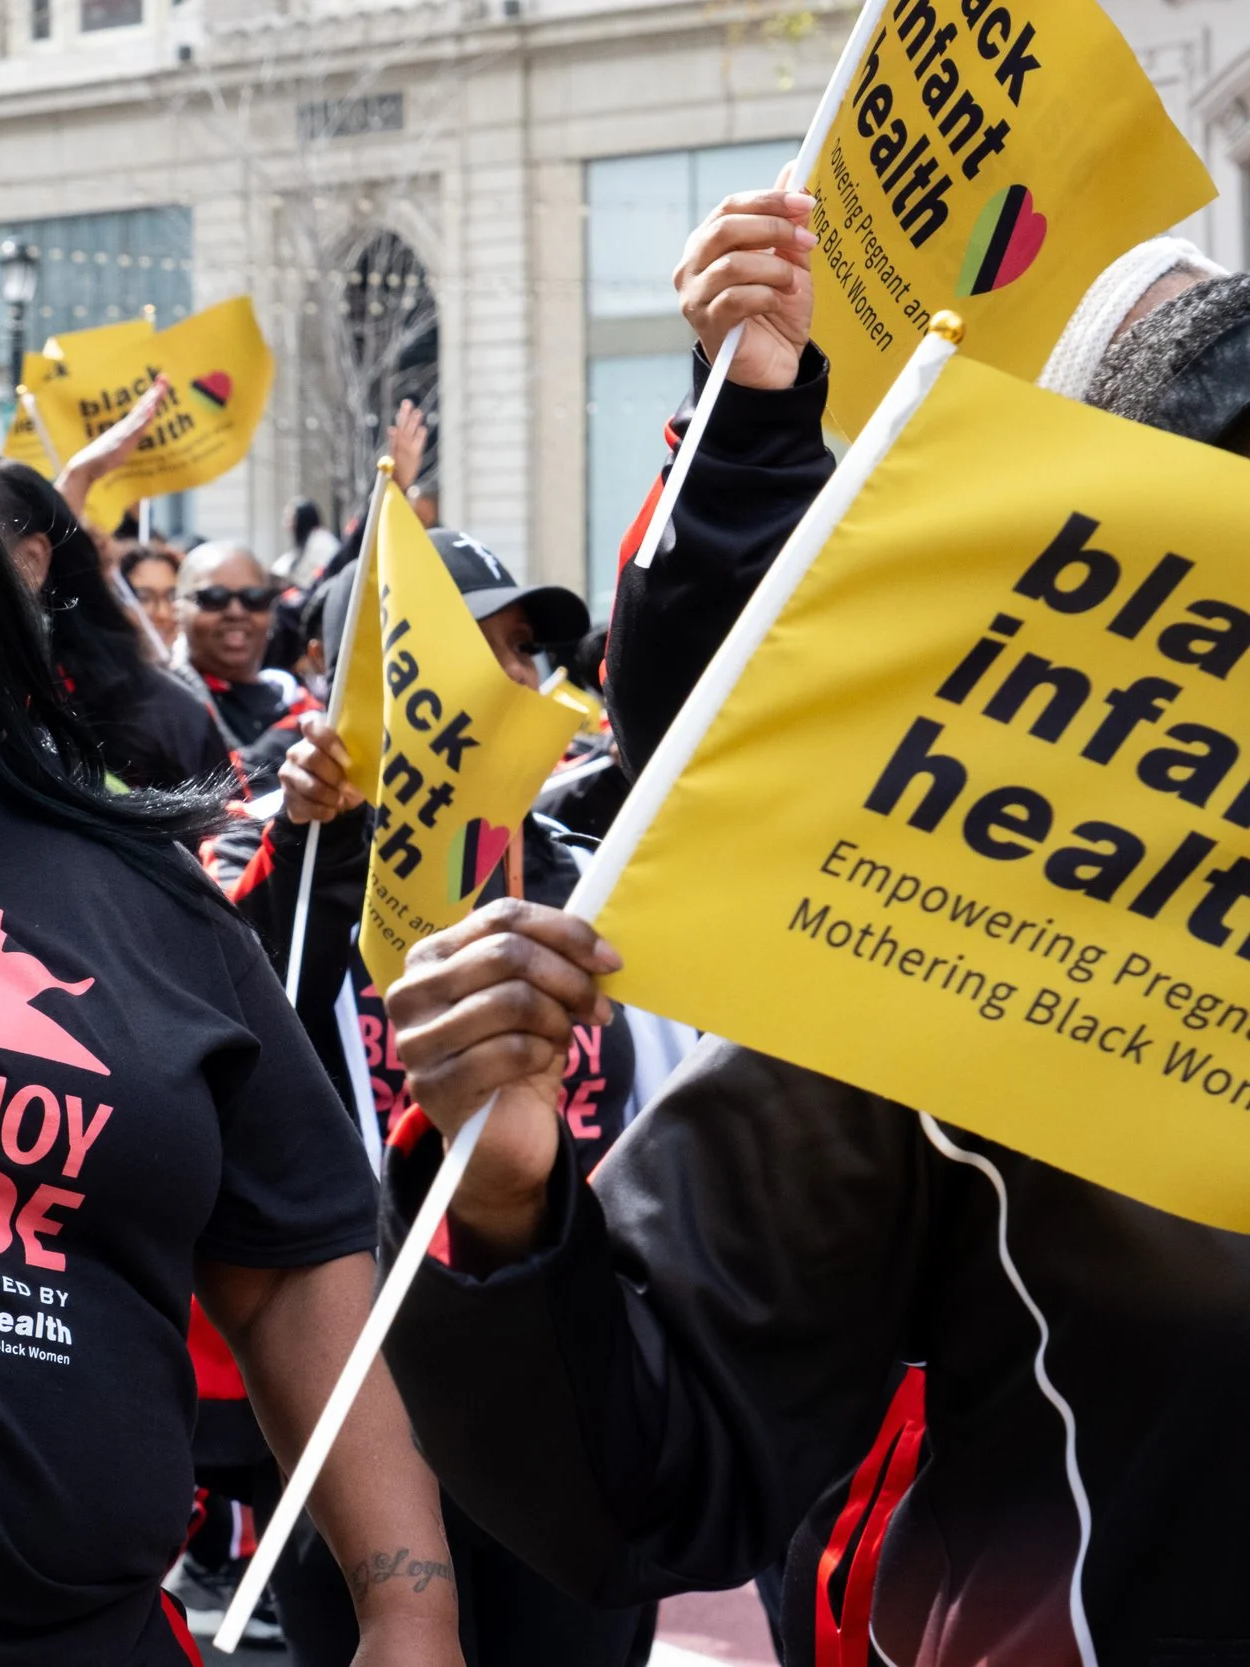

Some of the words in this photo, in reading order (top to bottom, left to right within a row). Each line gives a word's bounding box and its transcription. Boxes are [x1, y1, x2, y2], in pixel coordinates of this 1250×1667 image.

[823, 229, 854, 289] Black
[847, 275, 893, 352] Women
[855, 214, 912, 303] Pregnant
[136, 413, 194, 452] alth
[934, 612, 1250, 830] infa
[861, 714, 1250, 964] healt
[368, 903, 407, 952] men
[786, 895, 1018, 1022] Mothering
[1024, 987, 1154, 1066] Black
[819, 839, 1108, 983] Empowering
[1113, 952, 1250, 1042] Pregn
[40, 1286, 70, 1307] BY
[28, 1347, 70, 1366] Women
